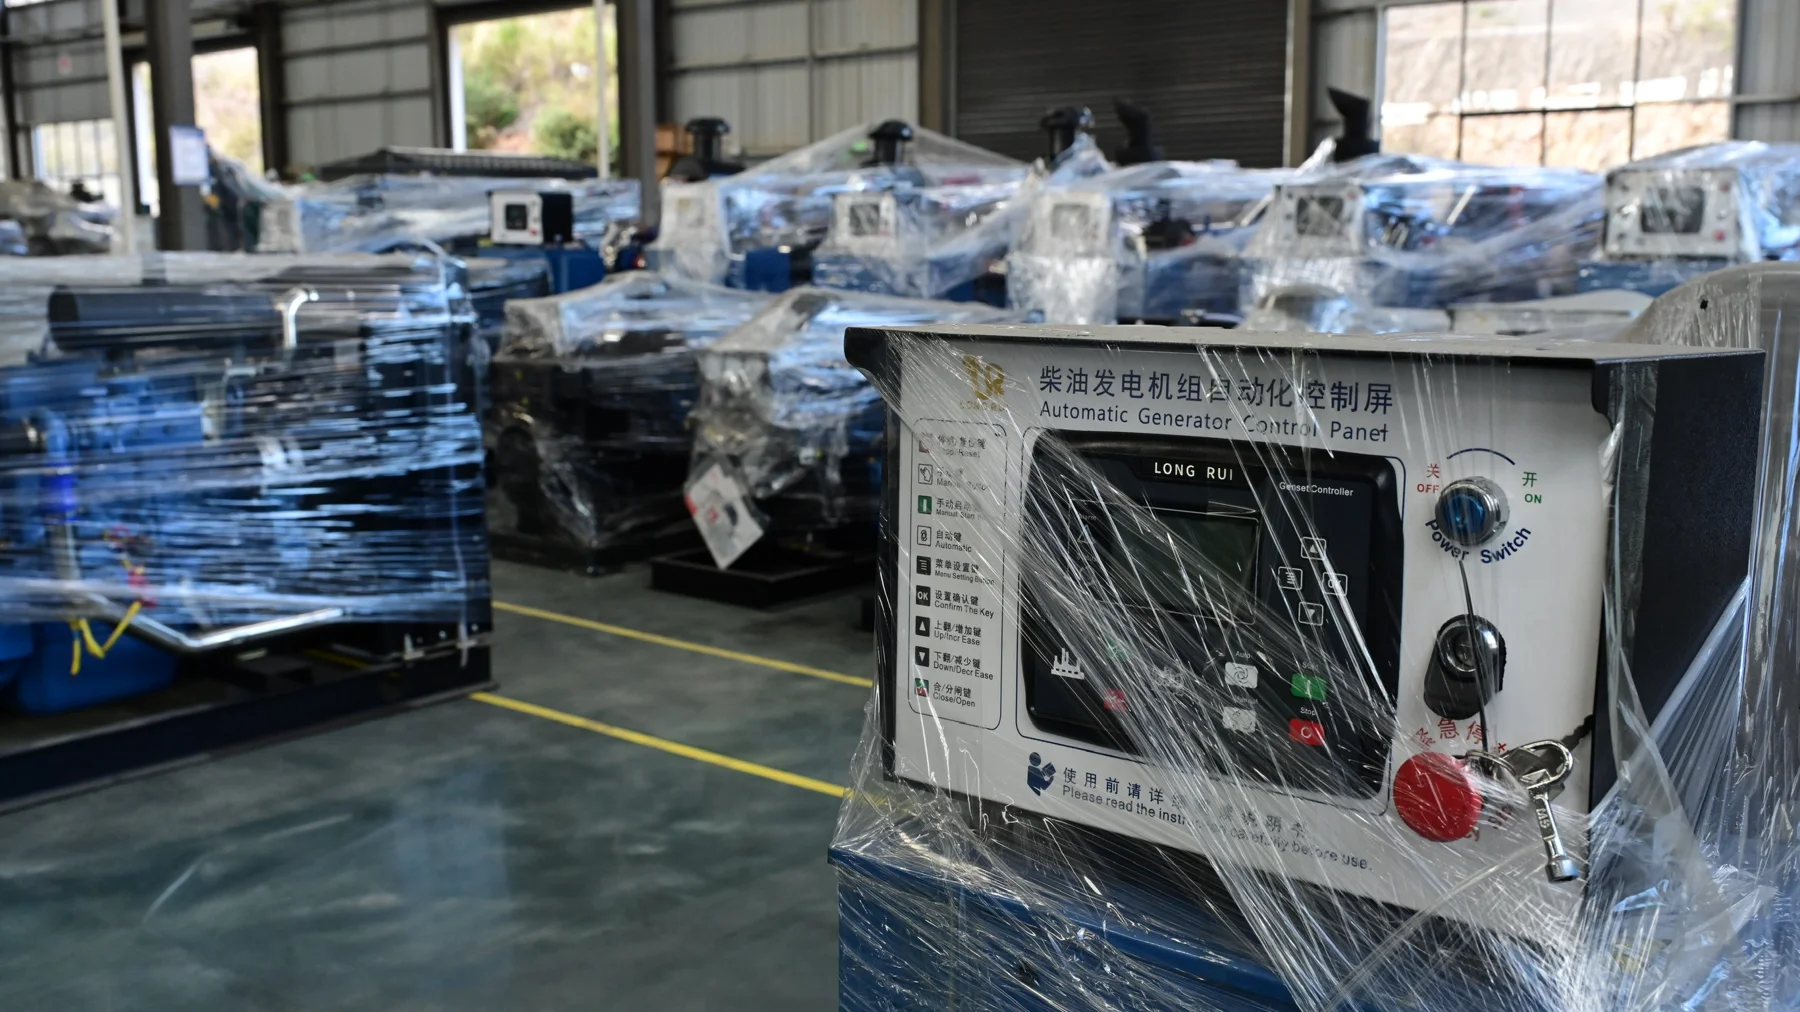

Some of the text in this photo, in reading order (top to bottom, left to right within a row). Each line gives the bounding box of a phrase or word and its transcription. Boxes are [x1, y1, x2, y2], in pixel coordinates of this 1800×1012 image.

[1040, 366, 1393, 415] 柴油发电机组自动化控制屏
[1040, 401, 1128, 423] Automatic
[1138, 408, 1232, 430] Generator
[1243, 415, 1317, 437] Control
[1154, 462, 1233, 481] LONG RUI
[1427, 464, 1440, 479] 关
[1522, 471, 1537, 487] 开
[1279, 481, 1354, 497] Genset Controller
[1417, 484, 1440, 494] OFF
[1524, 494, 1542, 504] ON
[935, 540, 973, 553] Automatic
[1425, 519, 1532, 564] Power Switch
[952, 572, 974, 583] Setting
[917, 590, 929, 601] OK
[935, 589, 979, 607] 设置确认键
[934, 600, 995, 619] Confirm The Key
[934, 630, 981, 646] Up/Incr Ease
[933, 660, 994, 681] Down/Decr Ease
[933, 691, 976, 707] Close/Open
[1062, 785, 1103, 805] Please
[1106, 797, 1133, 813] read
[1136, 802, 1156, 818] the
[1342, 853, 1373, 871] use.
